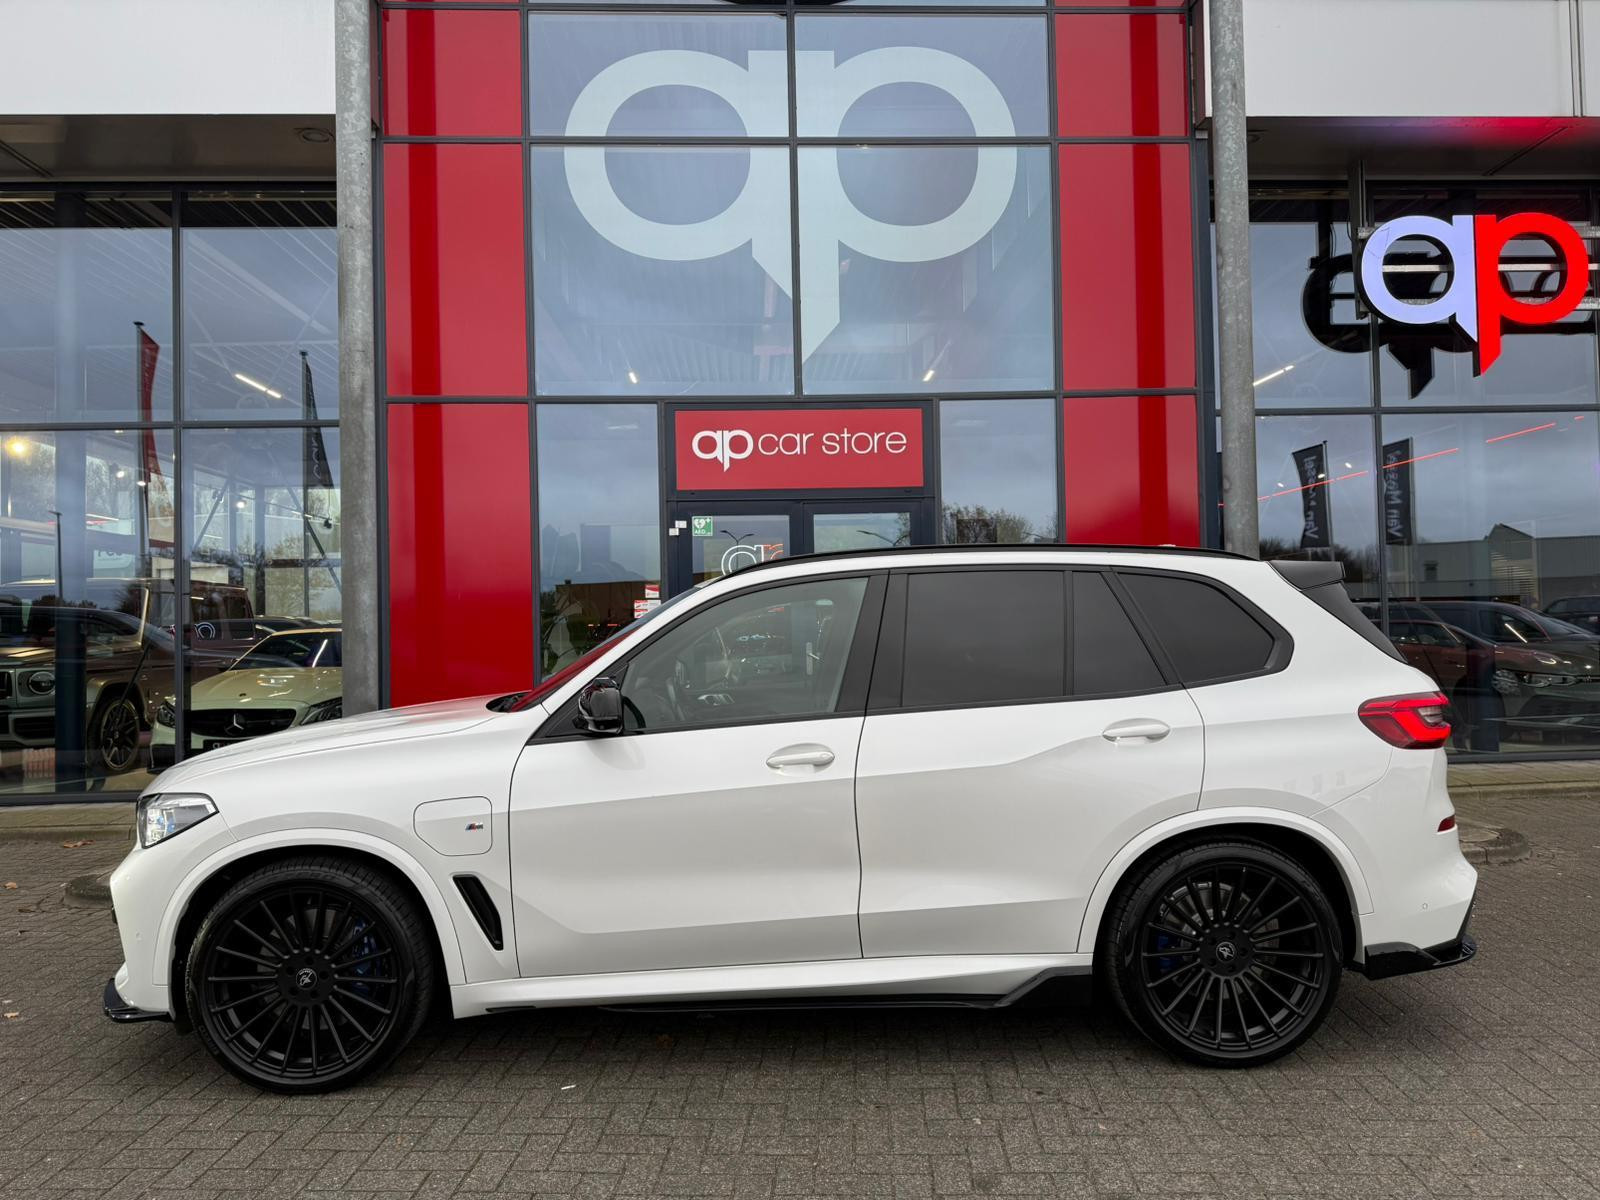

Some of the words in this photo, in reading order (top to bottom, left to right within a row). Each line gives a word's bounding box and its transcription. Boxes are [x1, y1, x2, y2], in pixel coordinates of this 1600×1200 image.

[563, 46, 1018, 365] ap
[1361, 212, 1589, 376] ap
[691, 429, 754, 473] ap
[758, 432, 814, 455] car
[821, 428, 907, 455] store
